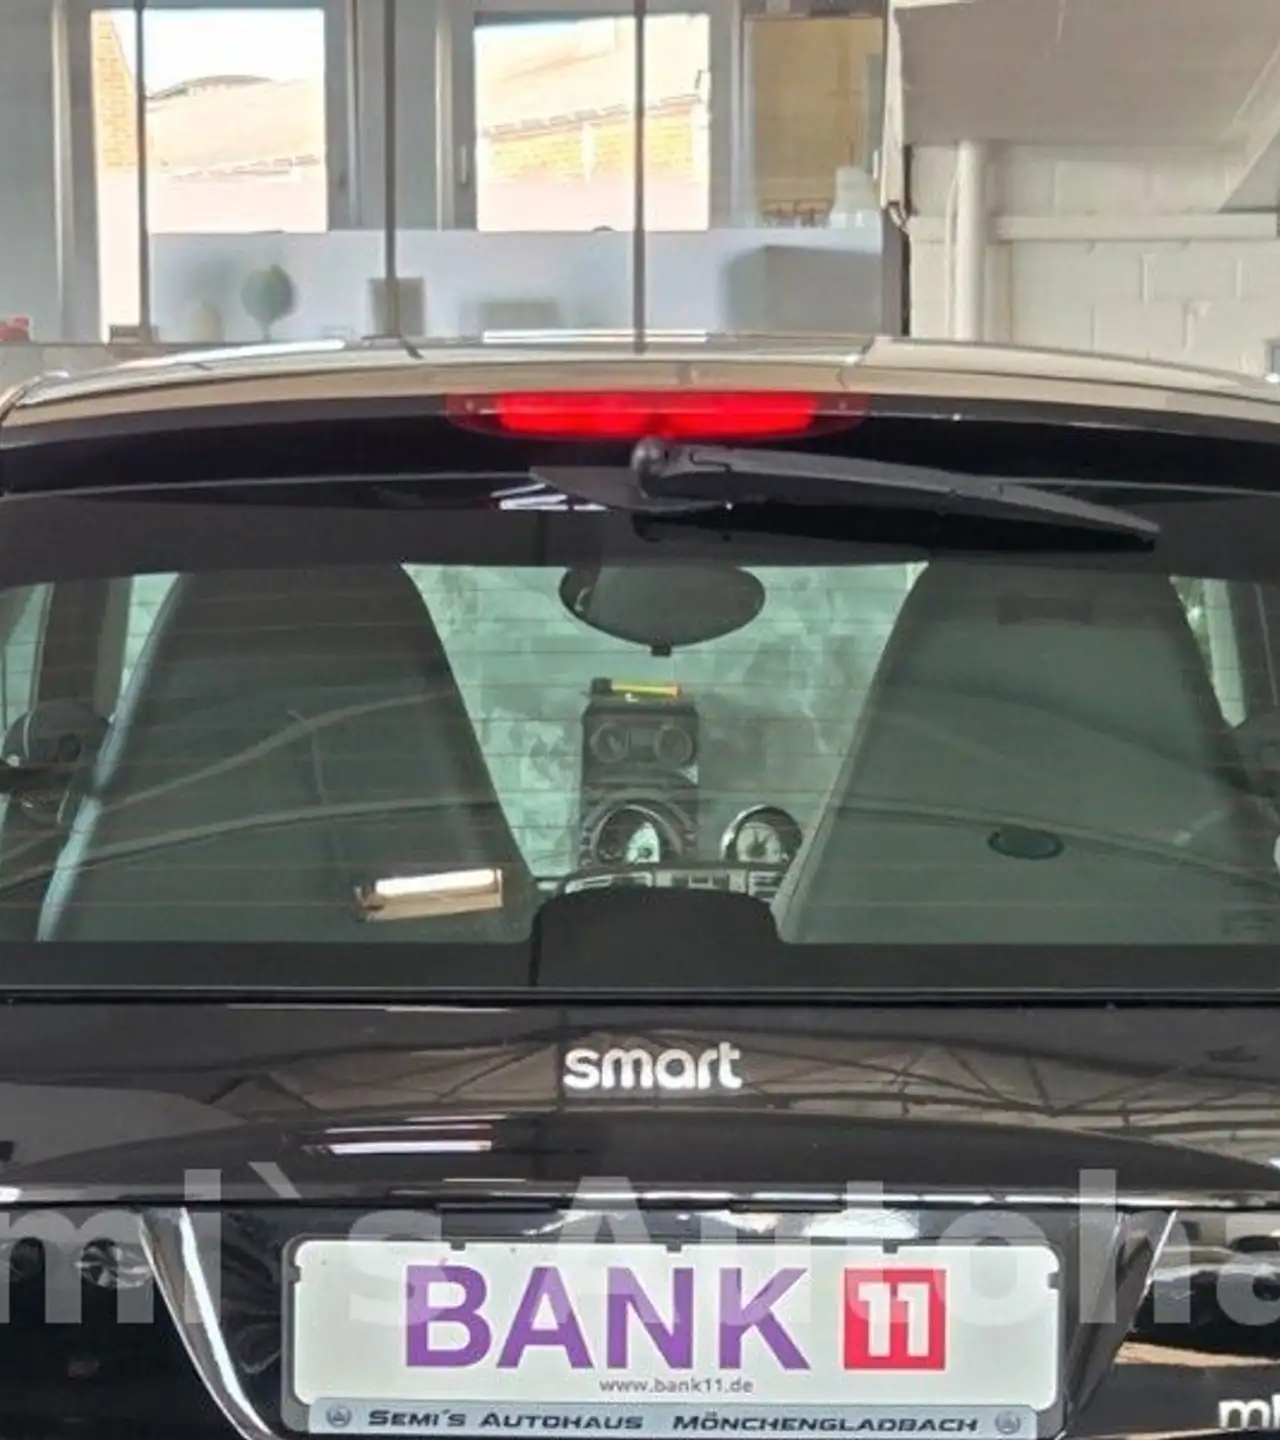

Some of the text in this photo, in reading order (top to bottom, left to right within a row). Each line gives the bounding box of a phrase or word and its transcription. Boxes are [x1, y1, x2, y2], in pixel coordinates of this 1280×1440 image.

[563, 1042, 743, 1090] smart
[405, 1265, 931, 1369] BANK 11
[599, 1377, 753, 1394] www.bank11.de
[479, 1411, 644, 1430] AUTOHAUS
[672, 1411, 979, 1432] MÖNCHENGLADBACH
